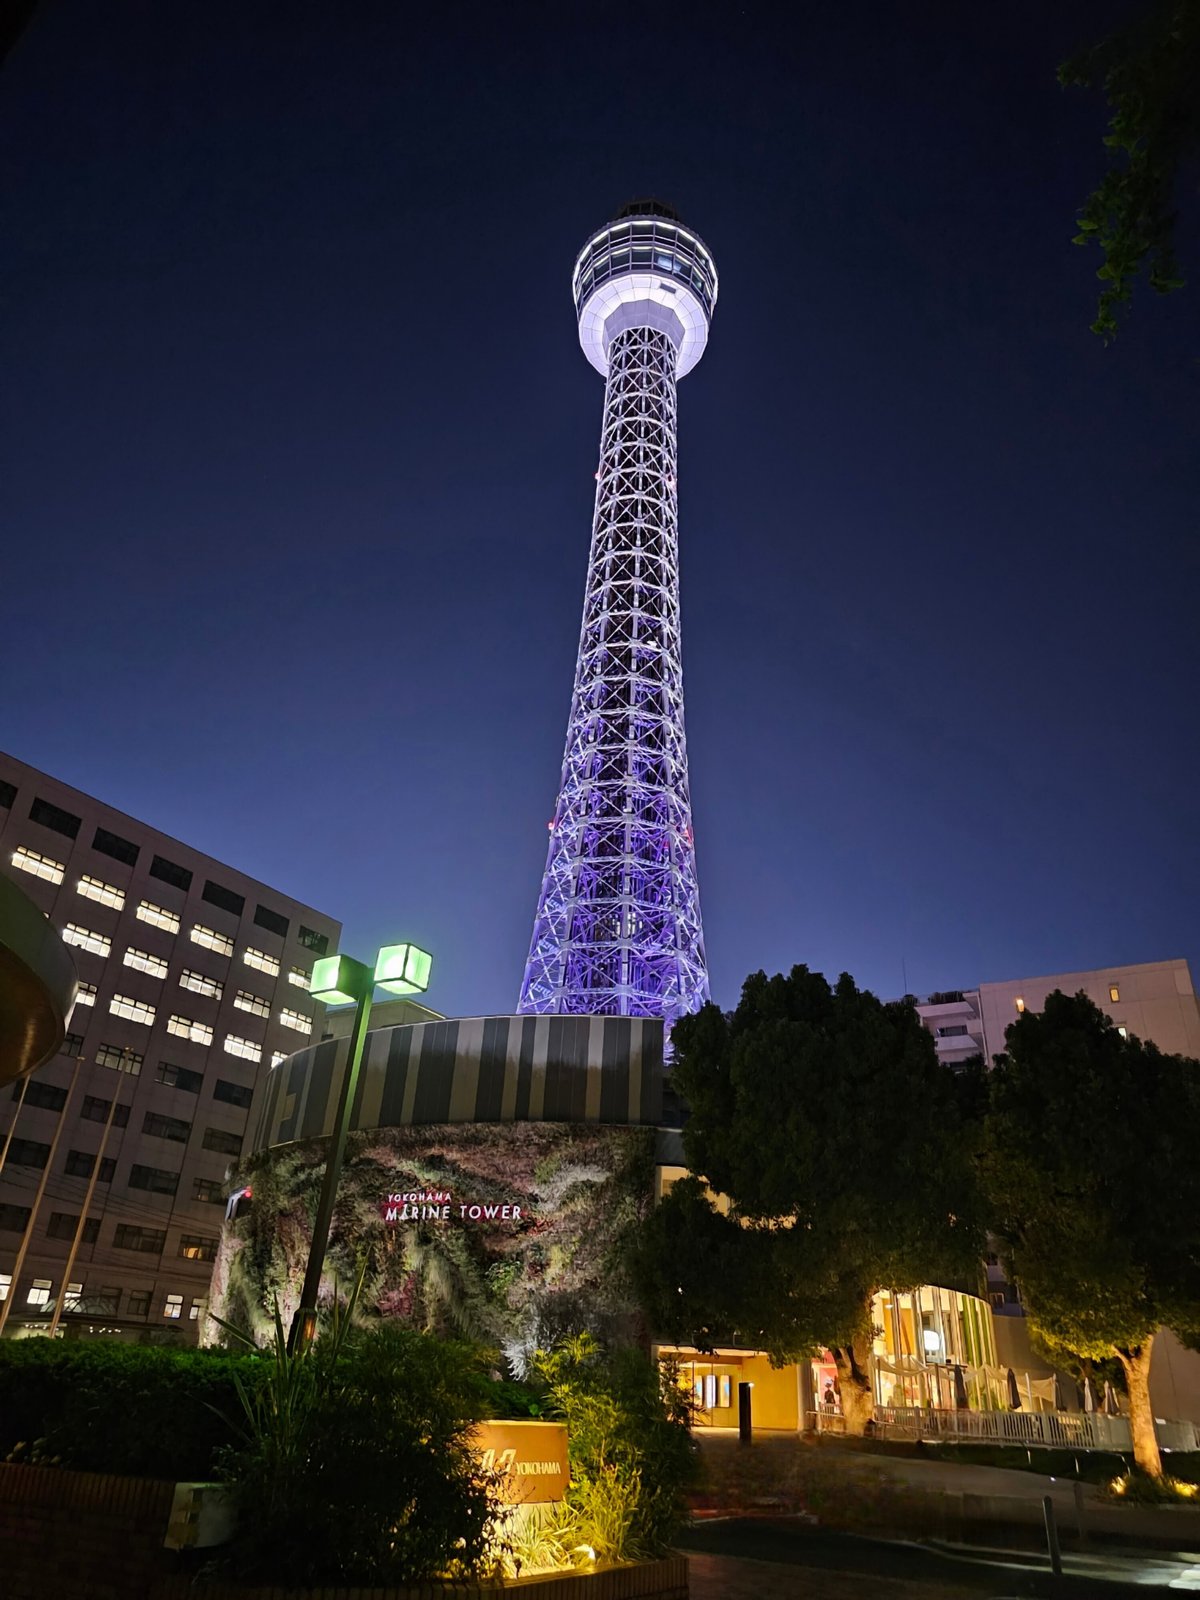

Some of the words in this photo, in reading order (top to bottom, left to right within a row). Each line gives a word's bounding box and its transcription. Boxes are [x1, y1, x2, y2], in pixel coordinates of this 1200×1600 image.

[388, 1193, 451, 1202] YOKOHAMA
[386, 1204, 451, 1220] MARINE
[460, 1205, 521, 1219] TOWER
[516, 1462, 561, 1475] YOKOHAMA
